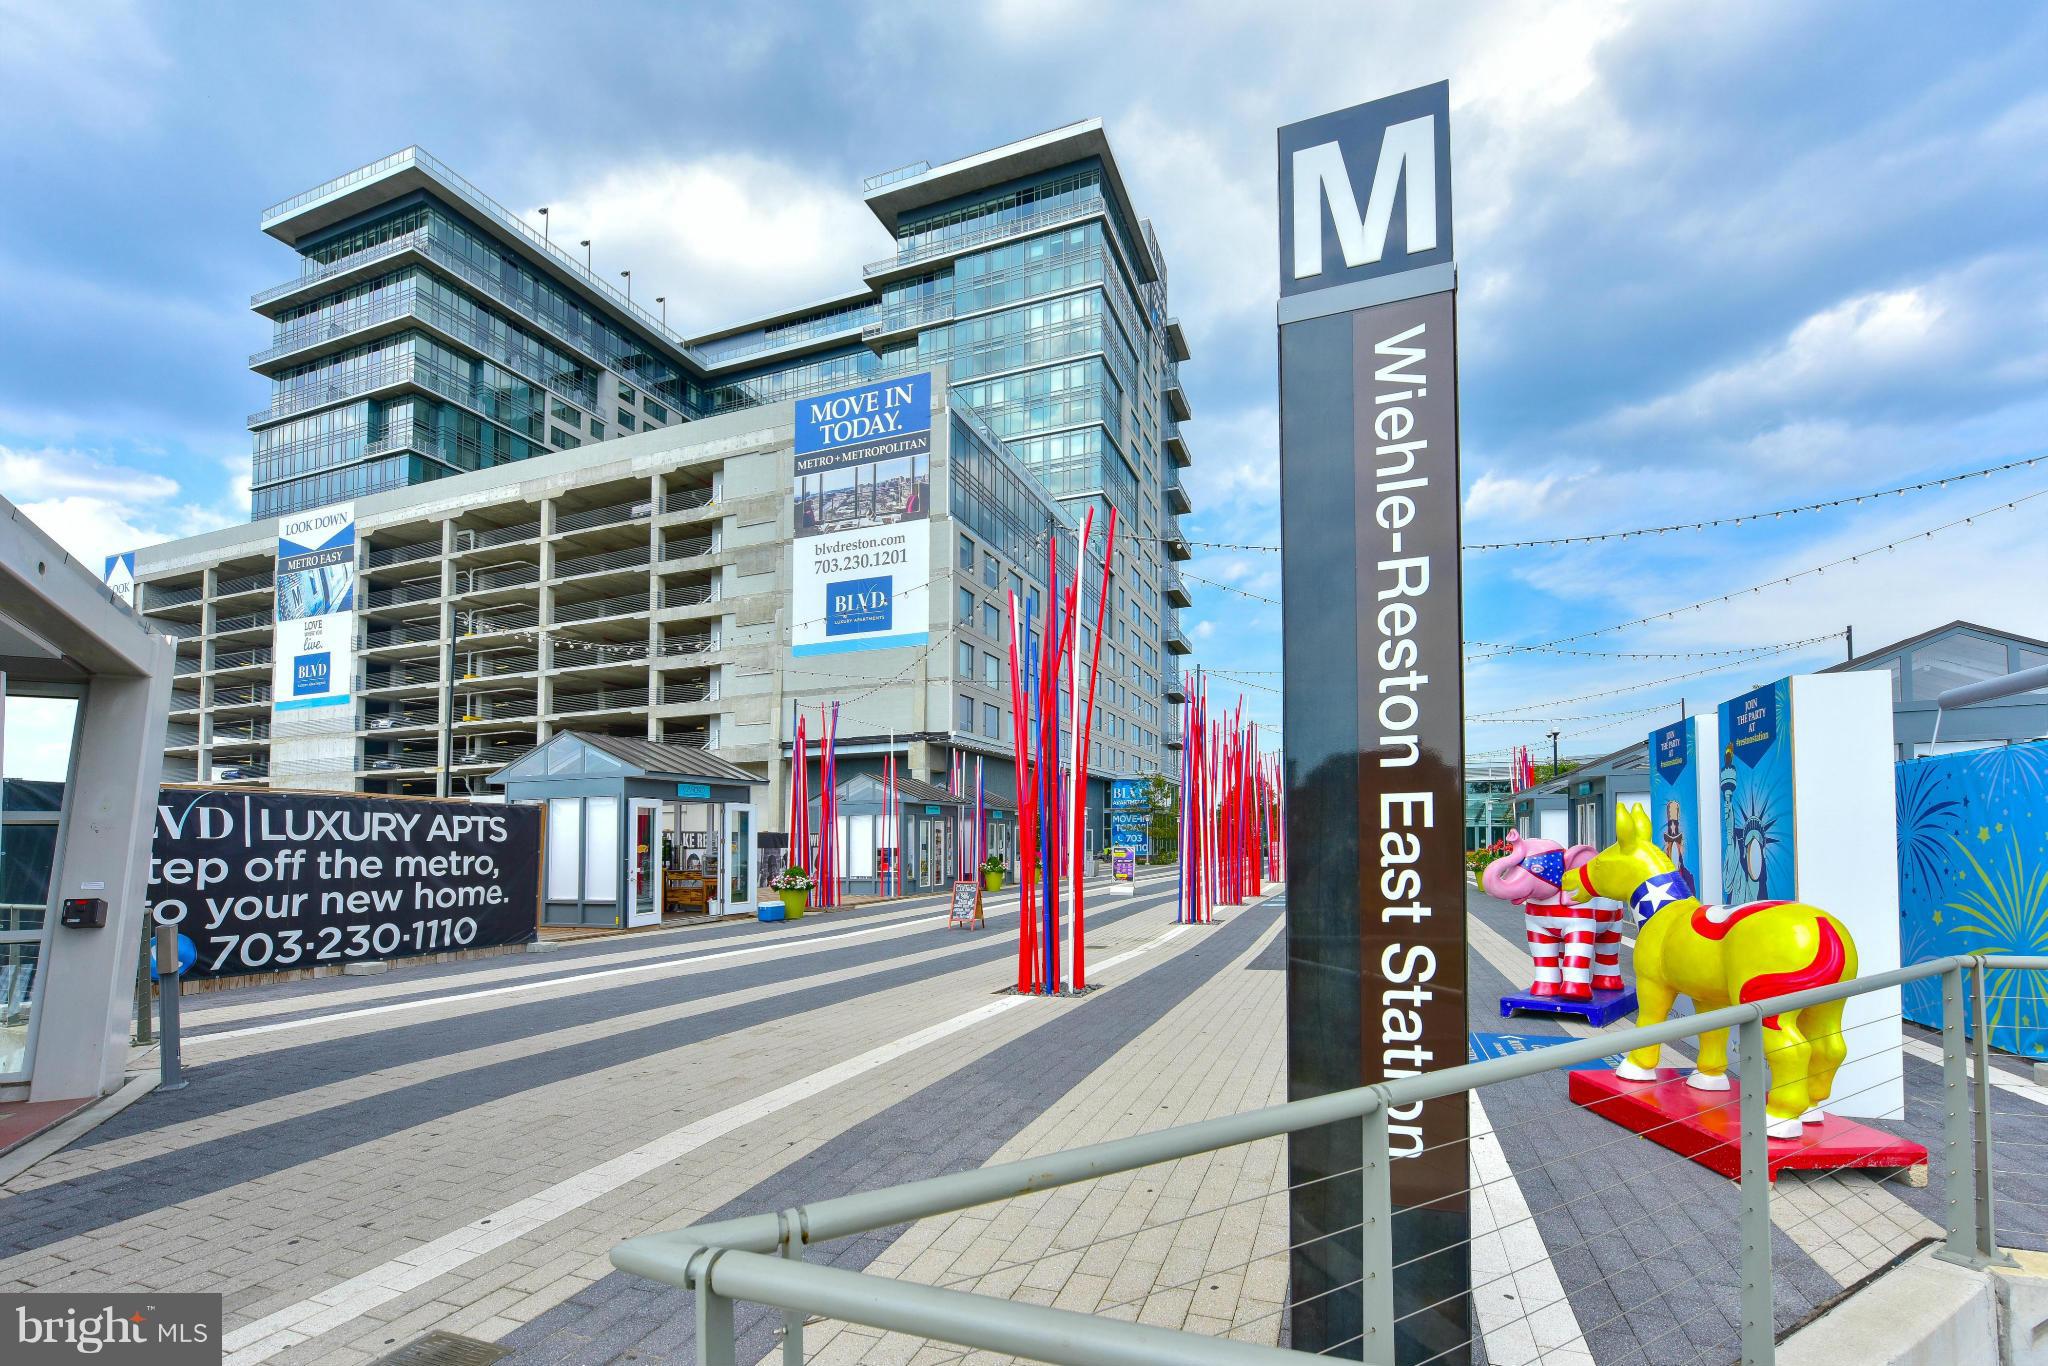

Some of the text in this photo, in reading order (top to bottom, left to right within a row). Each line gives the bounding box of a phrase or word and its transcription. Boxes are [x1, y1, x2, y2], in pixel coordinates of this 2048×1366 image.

[1292, 113, 1437, 280] M
[810, 383, 914, 424] MOVE IN
[819, 410, 903, 445] TODAY.
[797, 455, 834, 471] METRO
[841, 437, 928, 463] METROPOLITAN
[285, 511, 349, 536] LOOK DOWN
[814, 534, 906, 556] blvdreston.com
[1374, 322, 1431, 769] Wiehle-Reston
[287, 550, 344, 571] METRO EASY
[814, 548, 909, 575] 703.230.1201
[112, 582, 130, 594] OOK
[304, 619, 323, 631] LOVE
[298, 659, 328, 679] BLVD
[1736, 708, 1767, 726] THE PARTY
[1744, 697, 1758, 714] JOIN
[1748, 721, 1756, 733] AT
[260, 808, 422, 843] LUXURY
[426, 813, 508, 843] APTS
[1125, 834, 1143, 843] 703
[148, 848, 499, 891] tep off the metro,
[1379, 790, 1436, 924] East
[204, 892, 309, 931] your
[321, 889, 404, 914] new
[414, 881, 509, 911] home.
